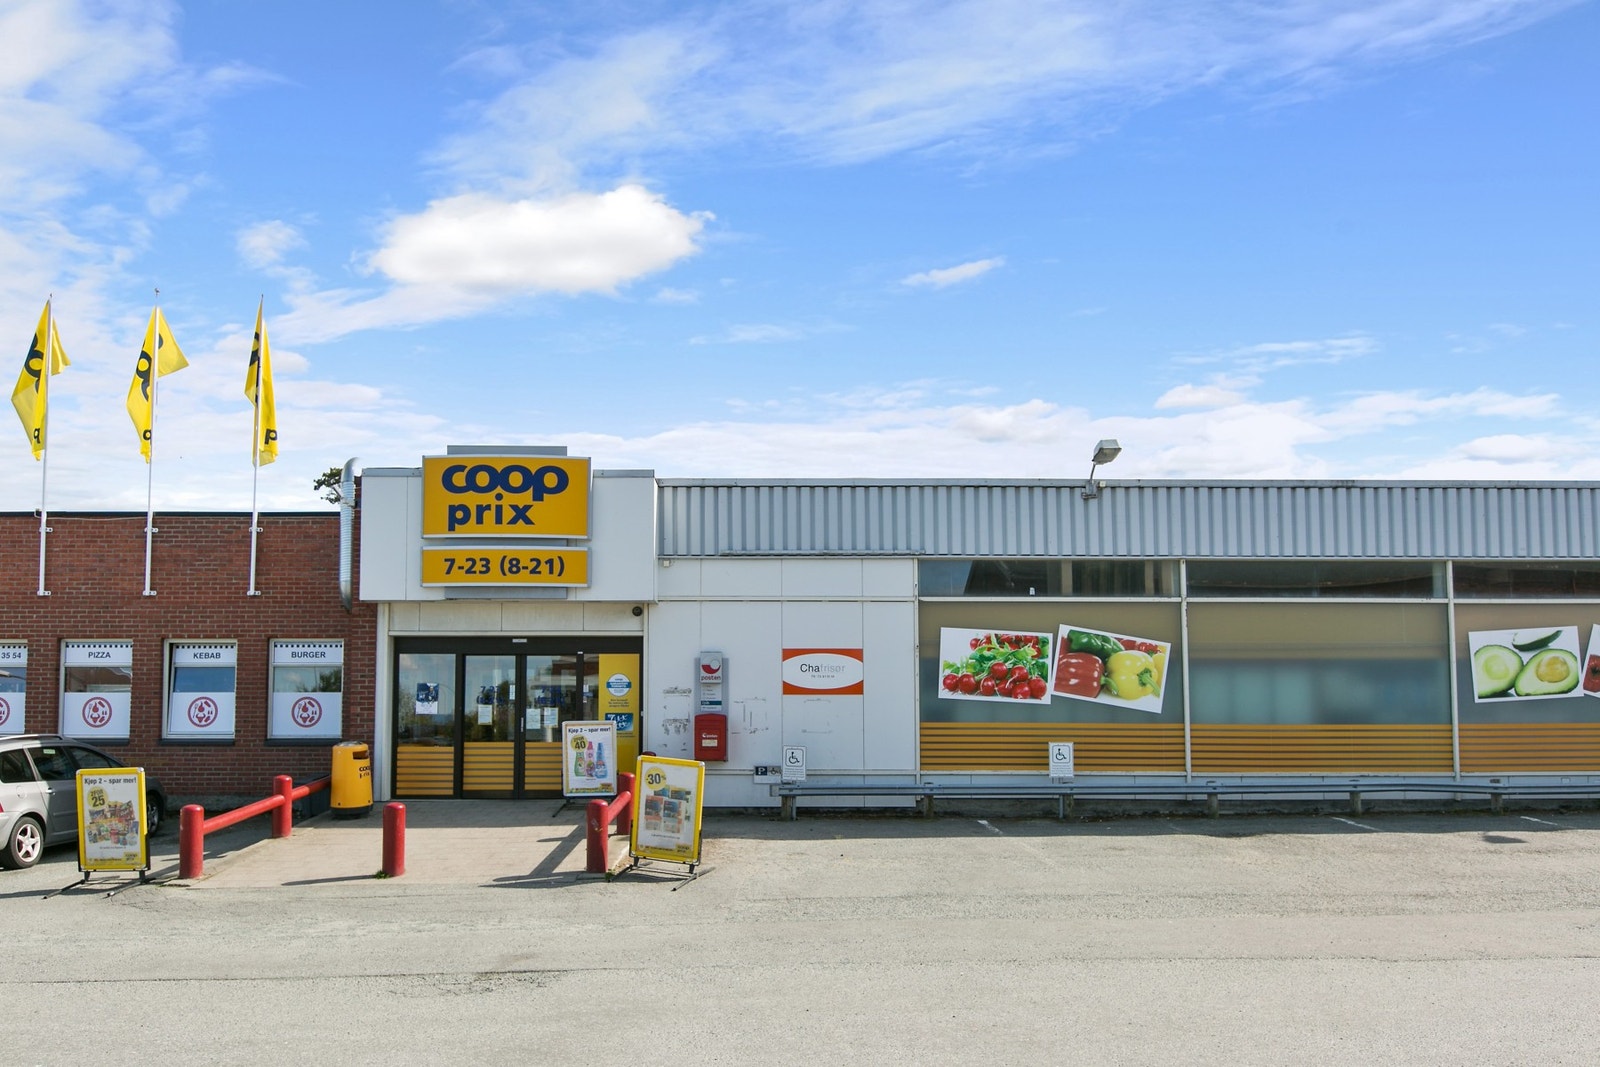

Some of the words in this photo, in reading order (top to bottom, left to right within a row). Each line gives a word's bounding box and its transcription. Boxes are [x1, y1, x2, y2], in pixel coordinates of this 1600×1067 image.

[441, 464, 569, 502] coop
[447, 493, 536, 532] prix
[443, 558, 491, 575] 7-23
[499, 555, 565, 577] (8-21)
[88, 651, 111, 659] PIZZA
[192, 652, 221, 660] KEBAB
[290, 651, 326, 659] BURGER
[575, 741, 586, 750] 40
[92, 796, 105, 807] 25
